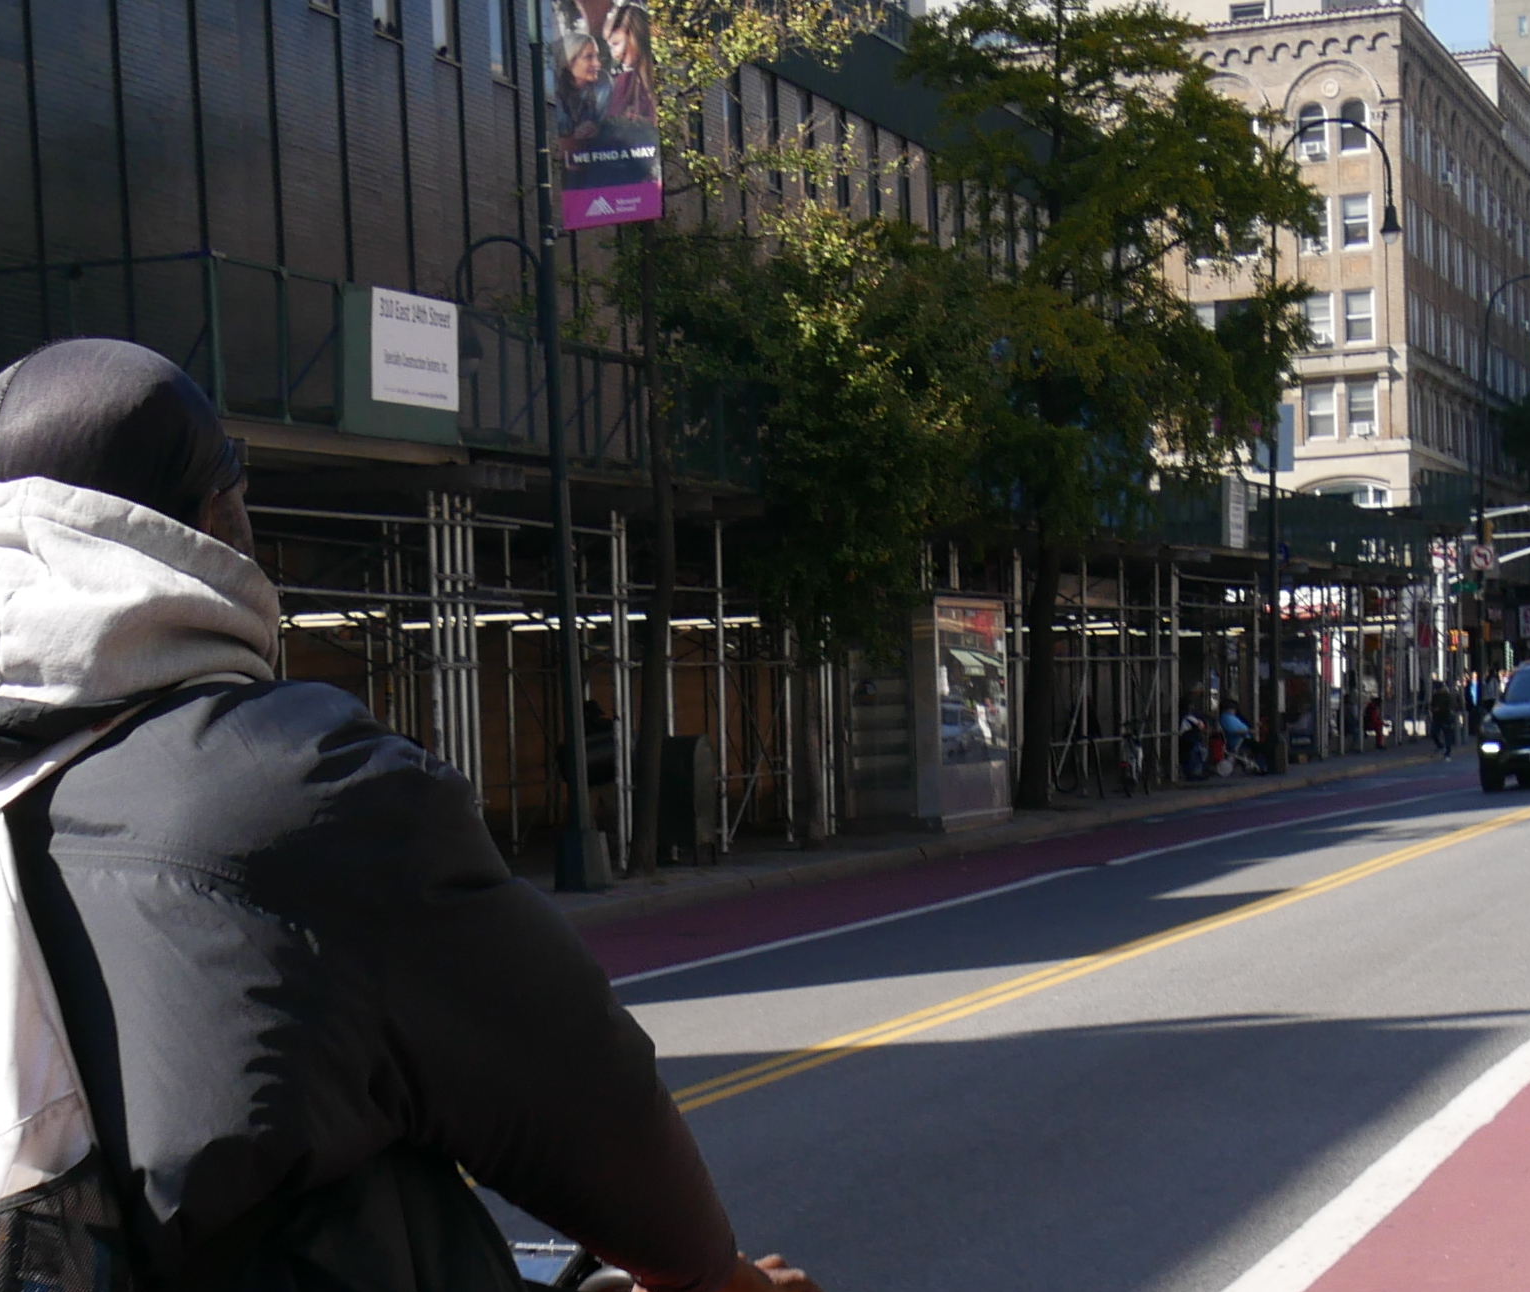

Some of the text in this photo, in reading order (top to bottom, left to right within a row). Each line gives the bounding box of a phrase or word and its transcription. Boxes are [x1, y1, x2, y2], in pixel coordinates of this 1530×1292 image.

[573, 146, 656, 163] WE FIND A WAY
[395, 301, 410, 322] East
[429, 307, 451, 329] Street
